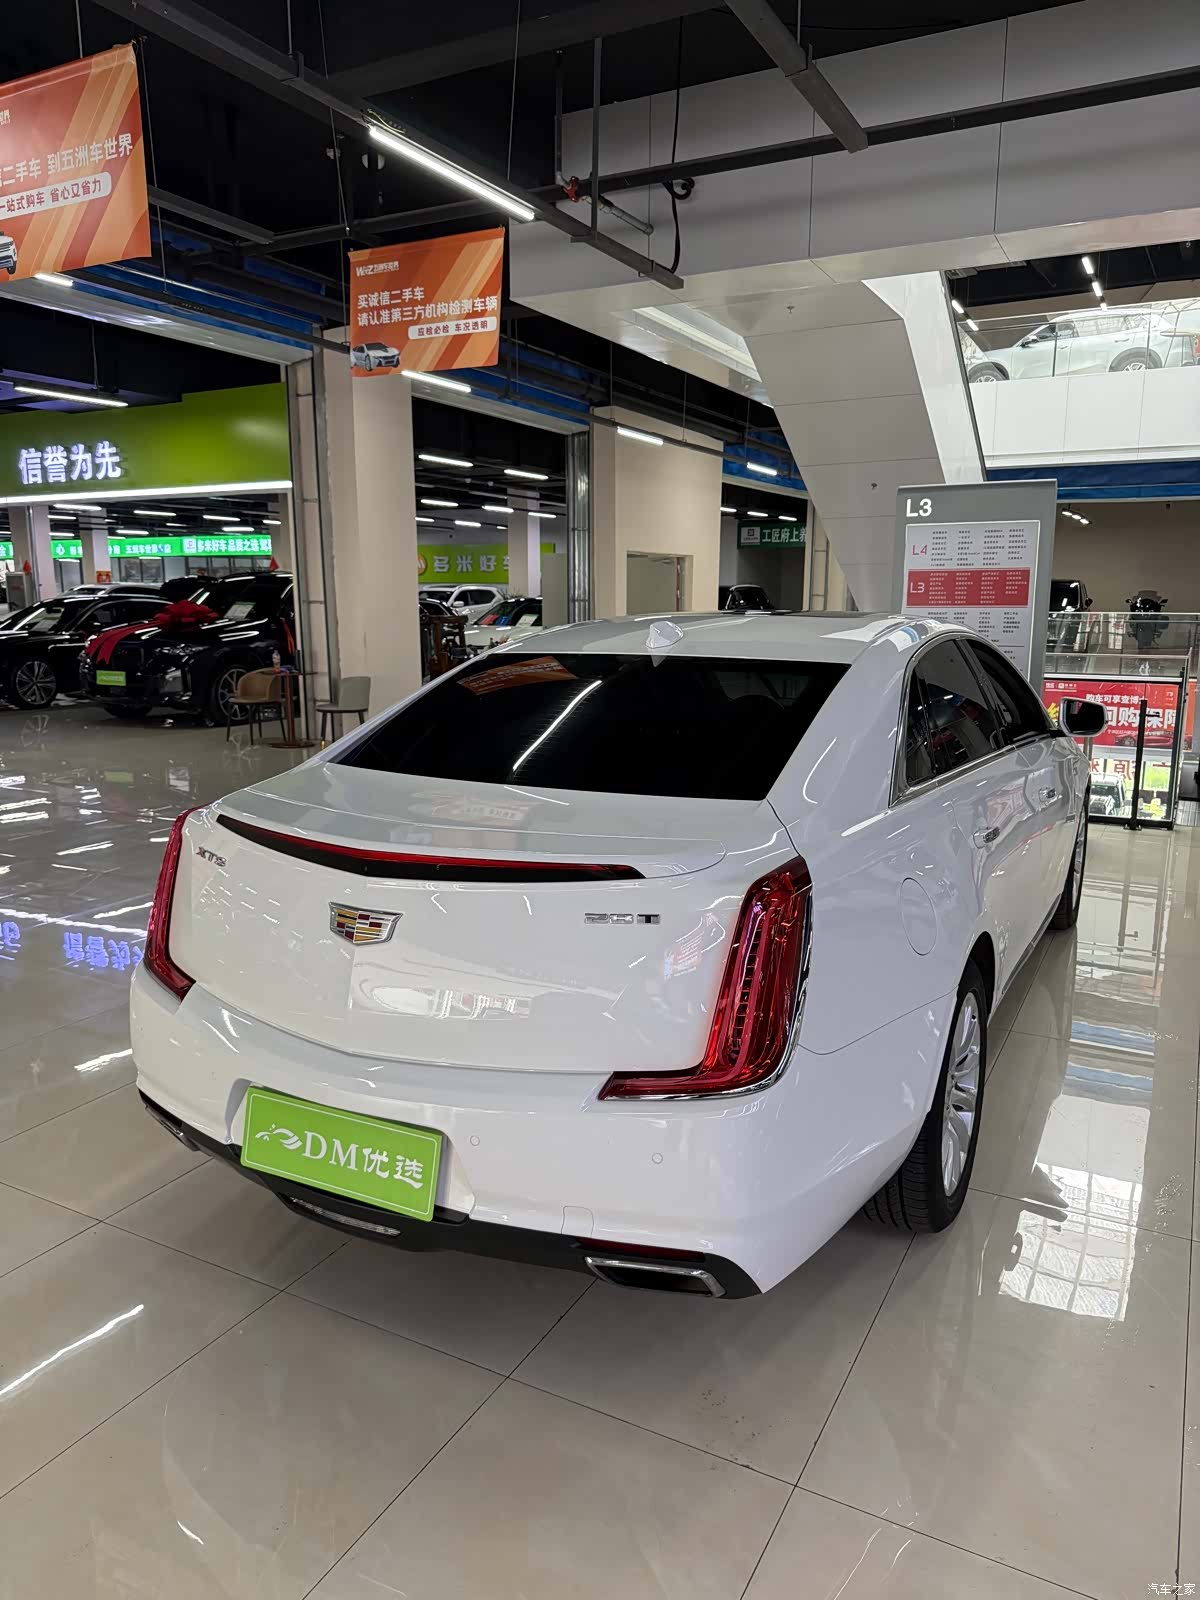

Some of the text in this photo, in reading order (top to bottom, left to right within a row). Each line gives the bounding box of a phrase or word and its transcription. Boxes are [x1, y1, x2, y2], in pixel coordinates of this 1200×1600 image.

[0, 132, 134, 188] 二手车 到五洲车世界
[50, 177, 102, 203] 省心又省力
[357, 286, 425, 309] 买诚信二手车
[357, 295, 498, 327] 请认准第三方机构检测车辆
[417, 320, 488, 336] 应检必检 车况透明
[19, 440, 122, 484] 信誉为先
[906, 498, 932, 517] L3
[912, 544, 928, 555] L4
[910, 582, 925, 593] L3
[196, 846, 227, 867] XTS
[584, 912, 660, 925] 28T
[302, 1130, 424, 1190] DM优选
